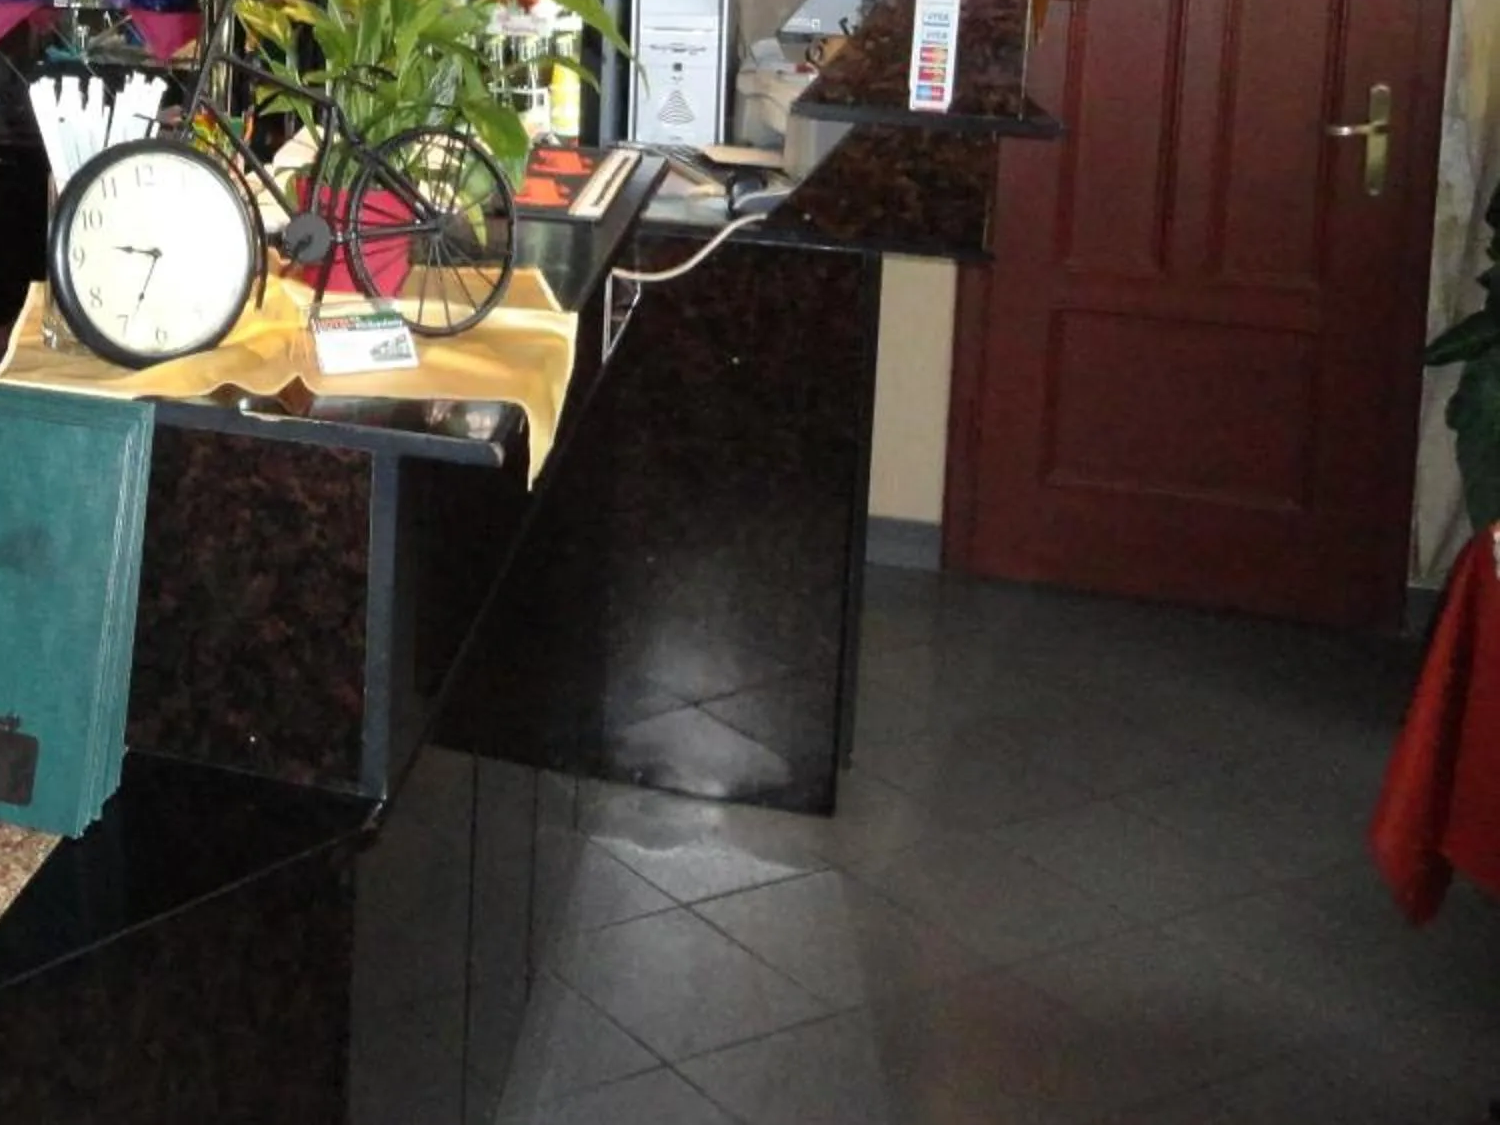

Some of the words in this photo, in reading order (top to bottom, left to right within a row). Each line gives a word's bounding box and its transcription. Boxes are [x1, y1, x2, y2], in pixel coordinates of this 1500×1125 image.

[134, 163, 155, 188] 12
[100, 176, 118, 200] 11
[81, 208, 104, 232] 10
[72, 245, 86, 270] 9
[88, 286, 104, 309] 8
[116, 313, 129, 338] 7
